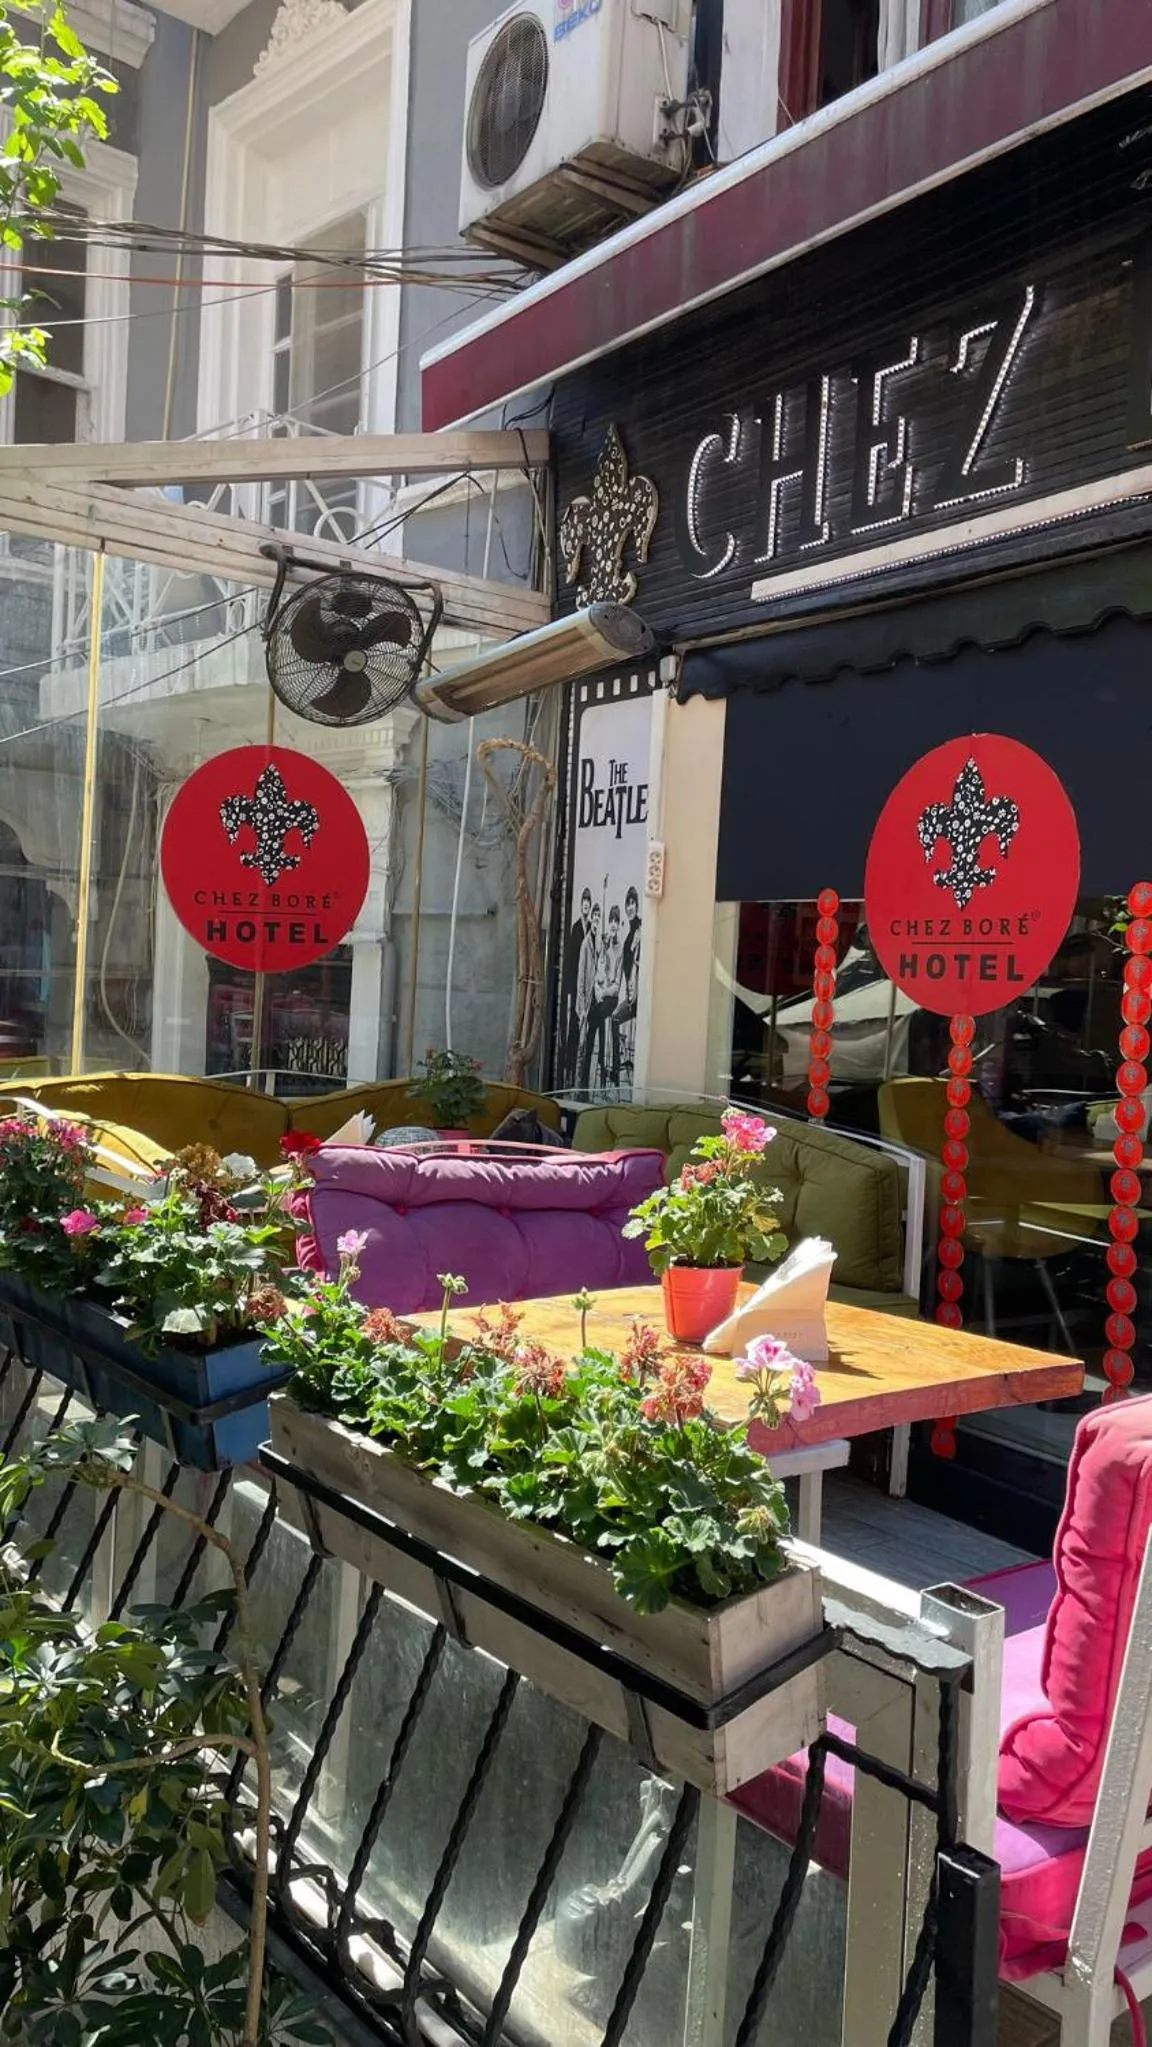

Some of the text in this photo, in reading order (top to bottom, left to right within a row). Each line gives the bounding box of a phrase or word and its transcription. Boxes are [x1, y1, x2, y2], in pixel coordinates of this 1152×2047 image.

[679, 285, 1036, 578] CHEZ
[609, 759, 628, 786] THE
[578, 758, 649, 839] BEATLE
[194, 890, 264, 908] CHEZ
[207, 920, 329, 944] HOTEL
[890, 919, 951, 936] CHEZ
[899, 953, 1025, 981] HOTEL
